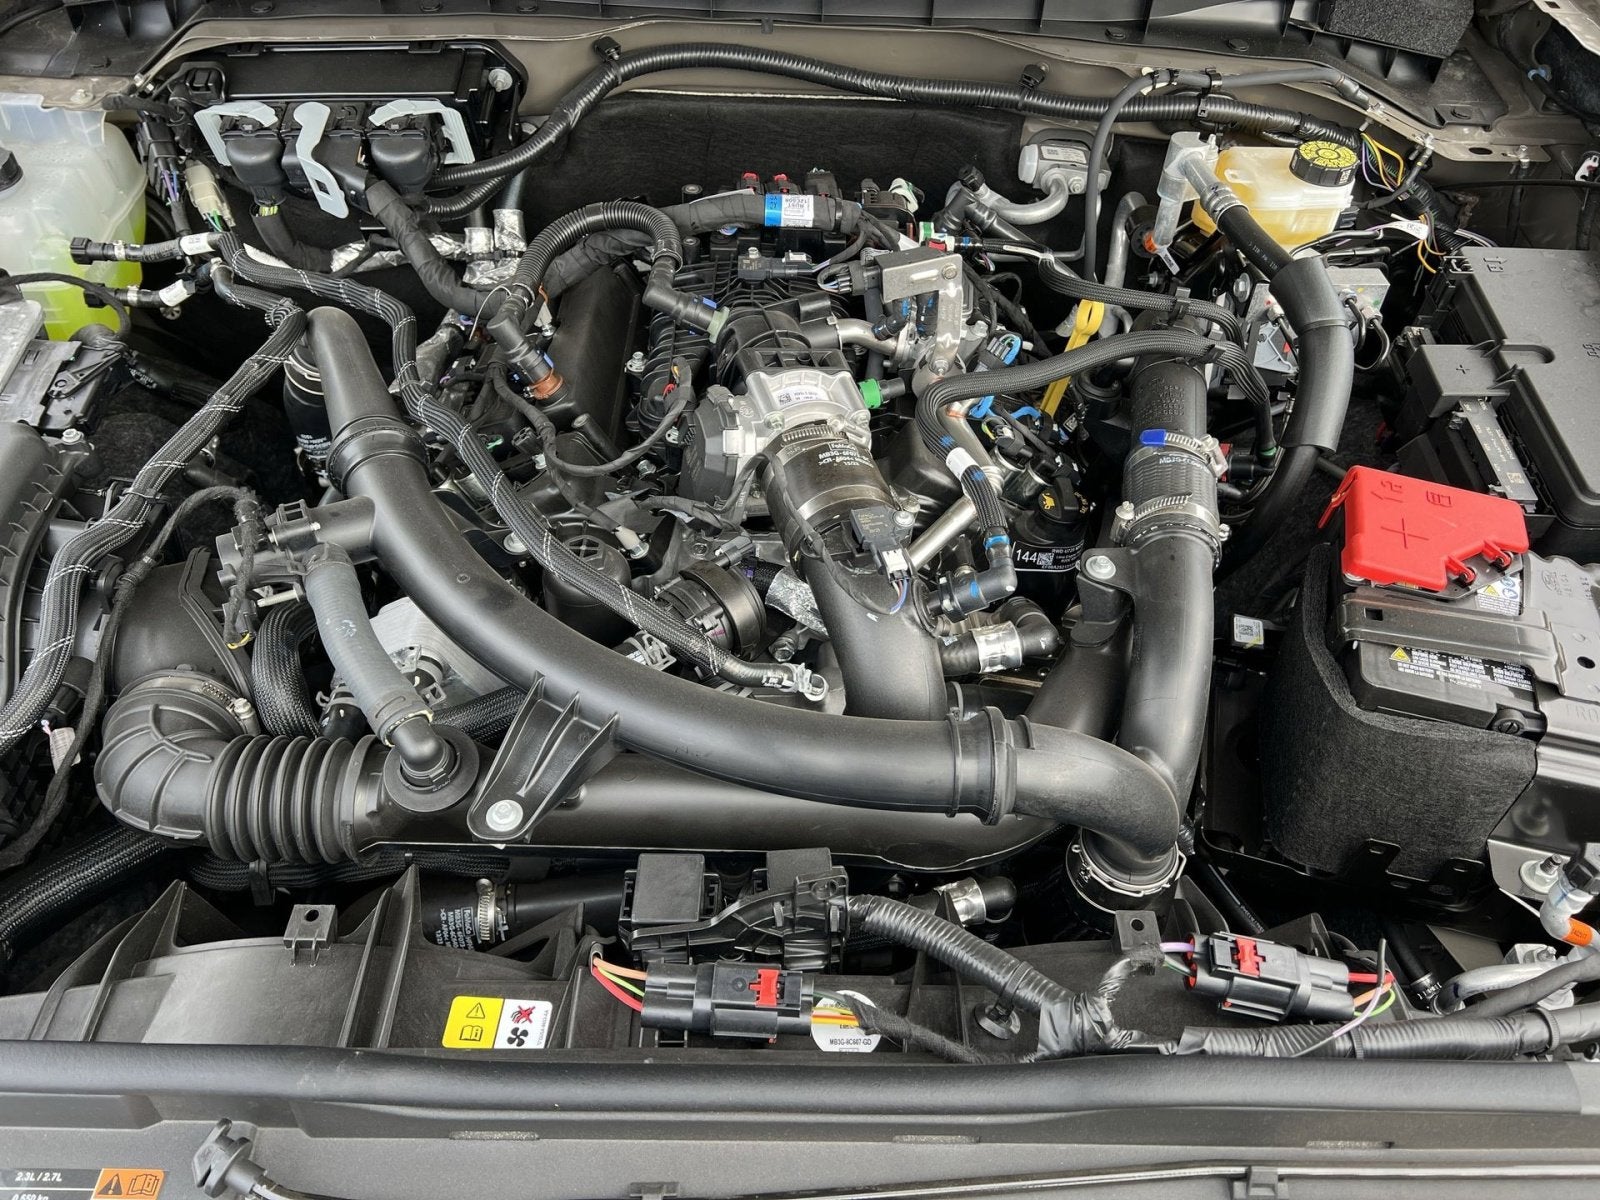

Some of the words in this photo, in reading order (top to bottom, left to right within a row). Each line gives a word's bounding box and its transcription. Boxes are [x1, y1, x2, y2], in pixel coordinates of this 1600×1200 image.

[1016, 549, 1037, 563] 144
[15, 1172, 35, 1182] 2.3L
[42, 1172, 62, 1182] 2.7L
